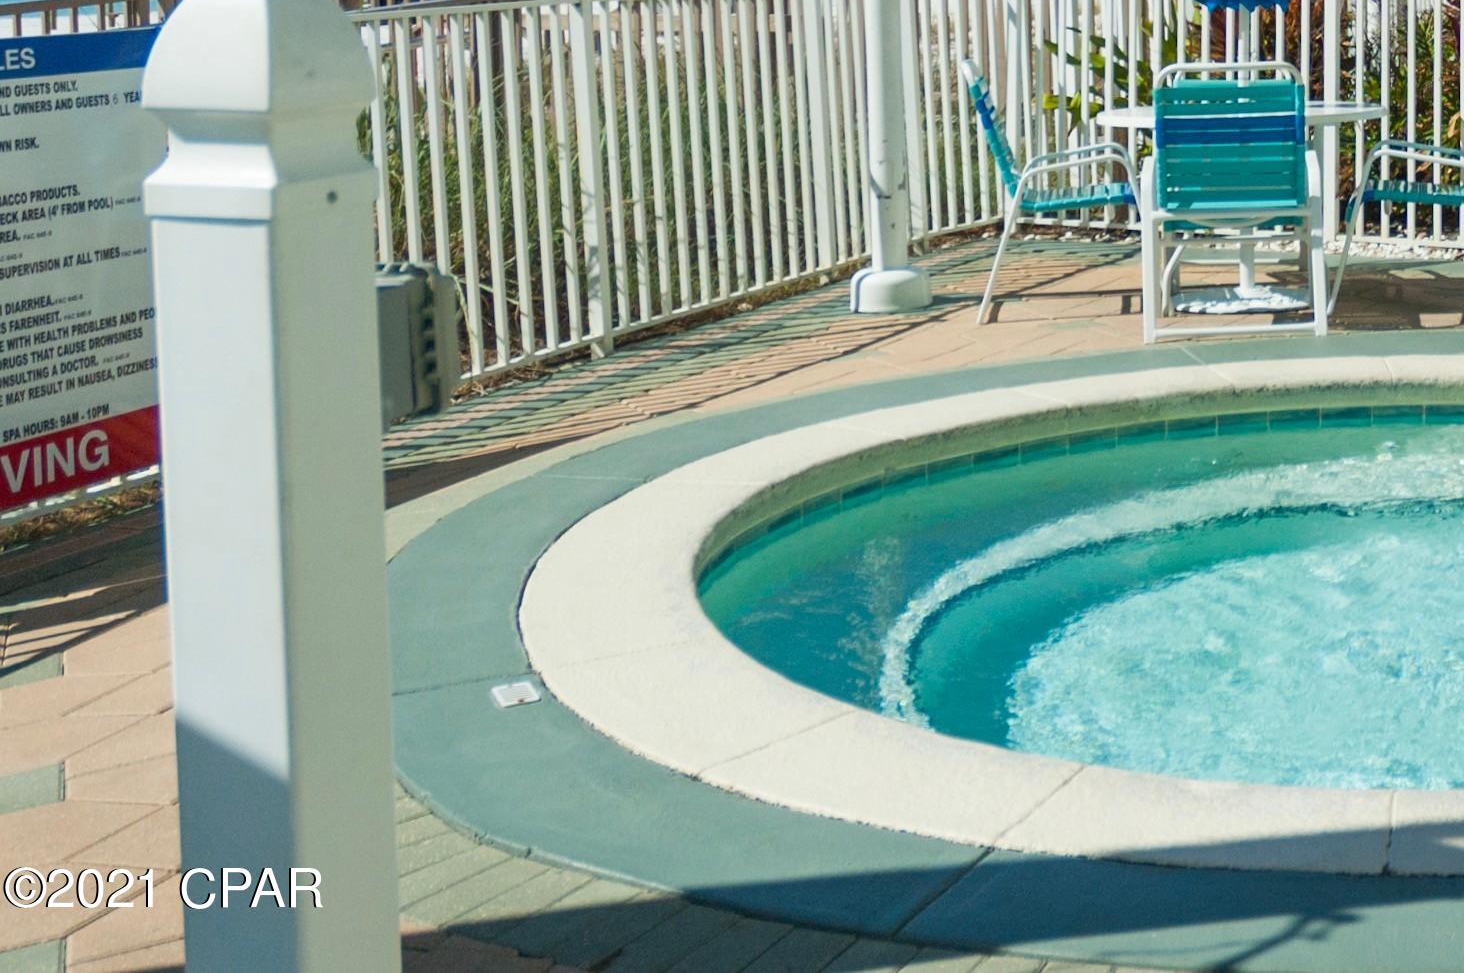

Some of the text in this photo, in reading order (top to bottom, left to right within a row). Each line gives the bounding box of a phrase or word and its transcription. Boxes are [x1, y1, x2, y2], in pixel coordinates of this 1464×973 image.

[0, 47, 35, 71] ES
[14, 82, 50, 97] GUESTS
[53, 80, 78, 93] ONLY.
[13, 101, 52, 115] OWNERS
[55, 98, 72, 110] AND
[76, 95, 109, 108] GUESTS
[123, 91, 141, 104] YEA
[15, 137, 39, 151] RISK.
[30, 184, 80, 203] PRODUCTS.
[22, 207, 45, 222] AREA
[61, 202, 85, 215] FROM
[88, 197, 113, 211] POOL)
[63, 255, 73, 268] AT
[76, 252, 92, 265] ALL
[95, 246, 120, 262] TIMES
[6, 295, 54, 315] DIARRHEA.
[7, 334, 31, 350] WITH
[34, 327, 69, 345] HEALTH
[72, 316, 117, 336] PROBLEMS
[120, 311, 137, 325] AND
[10, 311, 61, 331] FARENHEIT.
[31, 347, 55, 363] THAT
[57, 340, 86, 357] CAUSE
[89, 327, 143, 350] DROWSINESS
[52, 364, 58, 376] A
[61, 355, 98, 373] DOCTOR.
[6, 389, 25, 406] MAY
[29, 380, 63, 399] RESULT
[66, 377, 75, 391] IN
[78, 367, 114, 387] NAUSEA,
[3, 429, 21, 443] SPA
[24, 417, 58, 435] HOURS:
[61, 412, 79, 427] 9AM
[88, 404, 109, 420] 10PM
